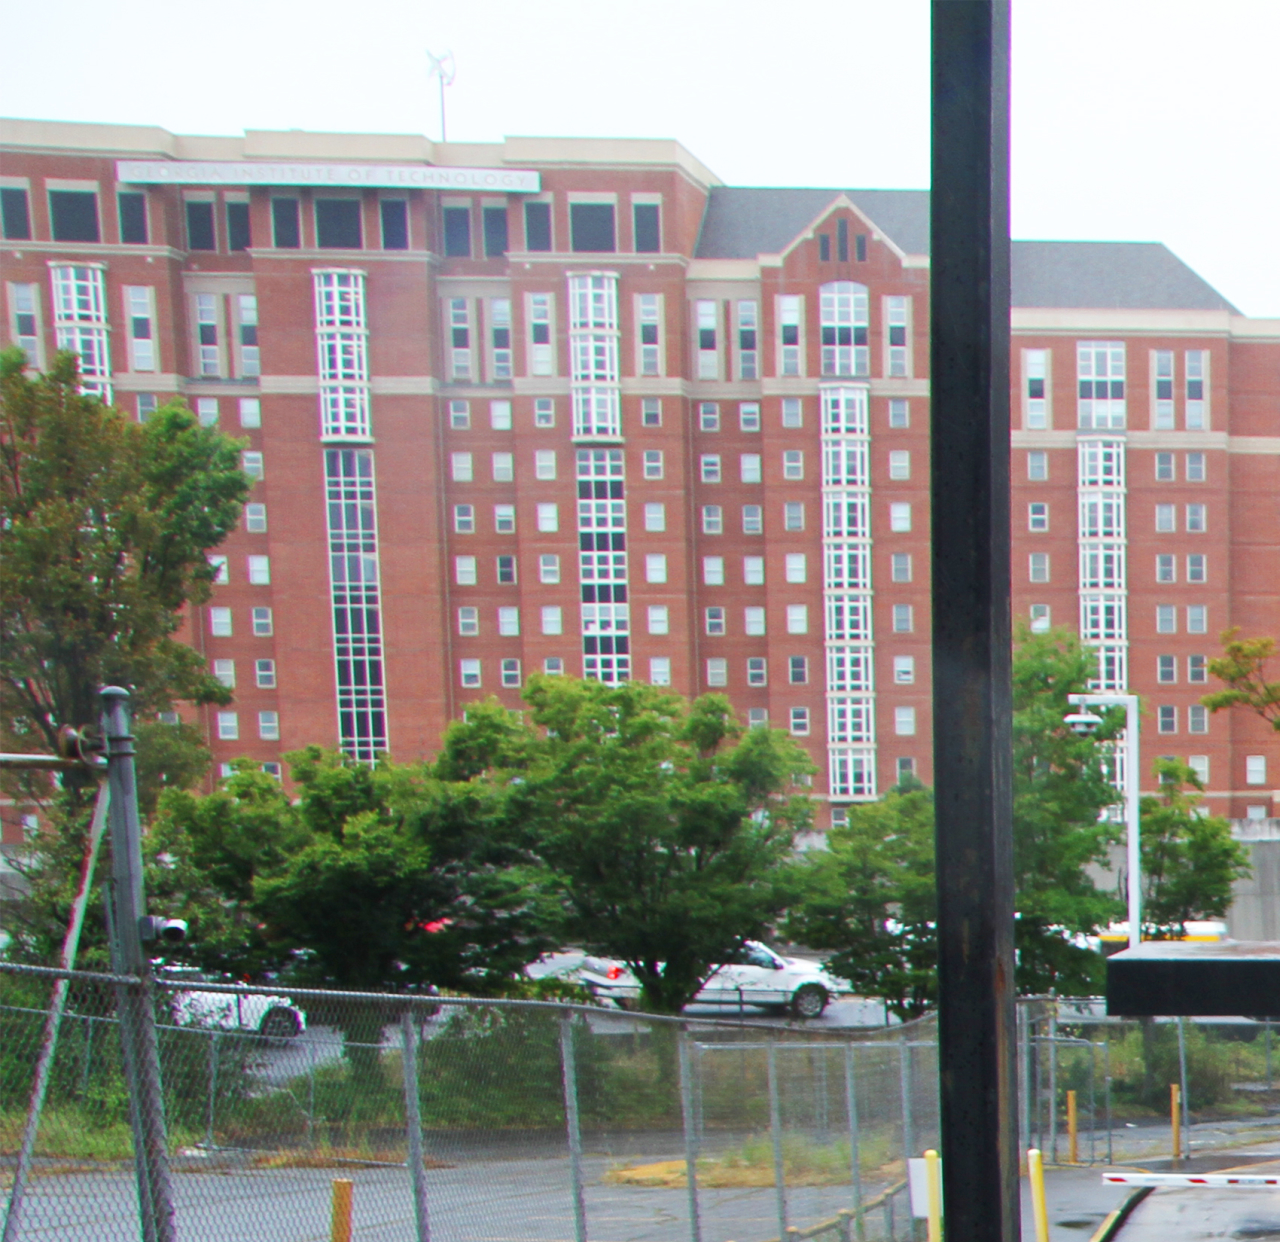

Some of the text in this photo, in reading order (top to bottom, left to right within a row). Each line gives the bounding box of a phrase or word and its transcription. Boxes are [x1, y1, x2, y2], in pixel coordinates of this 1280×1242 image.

[130, 166, 527, 187] GEORGIA INSTITUTE OF TECHNOLOGY
